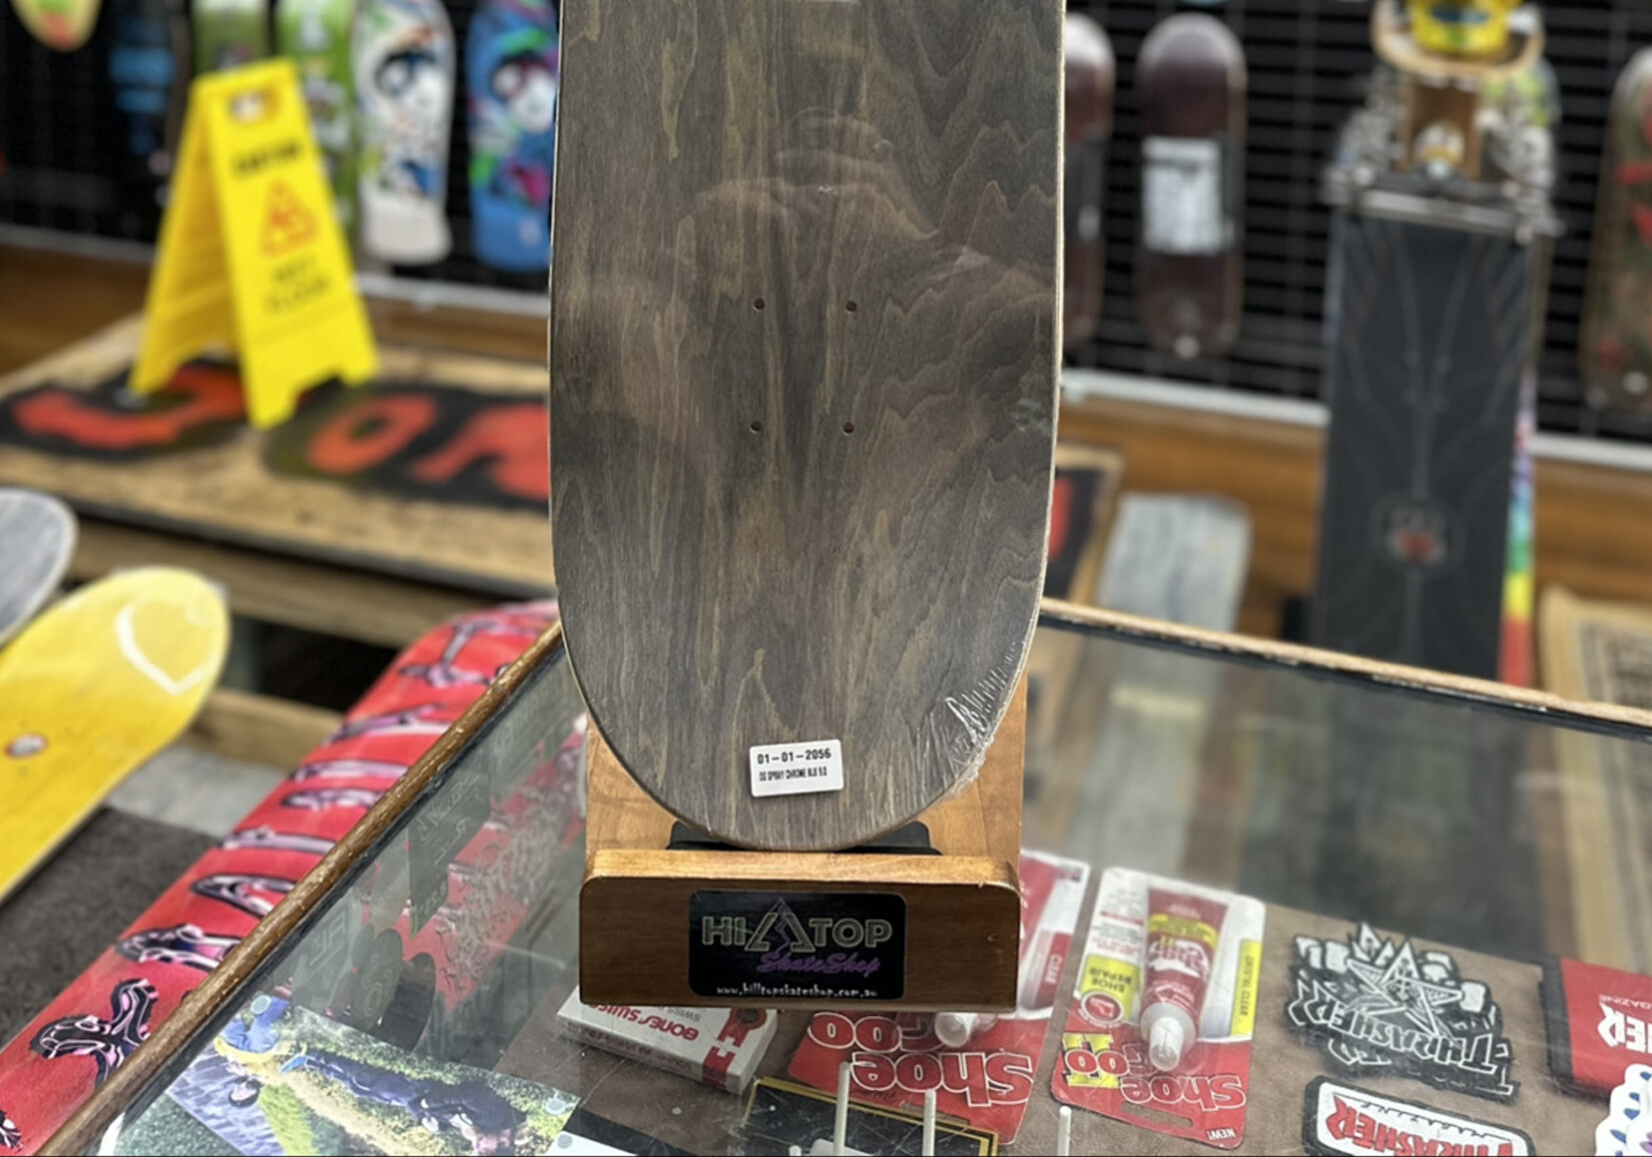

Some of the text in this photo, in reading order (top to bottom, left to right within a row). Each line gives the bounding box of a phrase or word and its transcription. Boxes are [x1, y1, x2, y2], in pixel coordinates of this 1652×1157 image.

[757, 748, 832, 765] 01-01-2056
[1092, 977, 1126, 994] SHOE
[638, 1014, 700, 1042] BONES
[1304, 978, 1498, 1075] THRASHER
[1597, 1002, 1652, 1054] ER
[851, 1051, 1034, 1108] Shoe
[1120, 1073, 1247, 1112] Shoe
